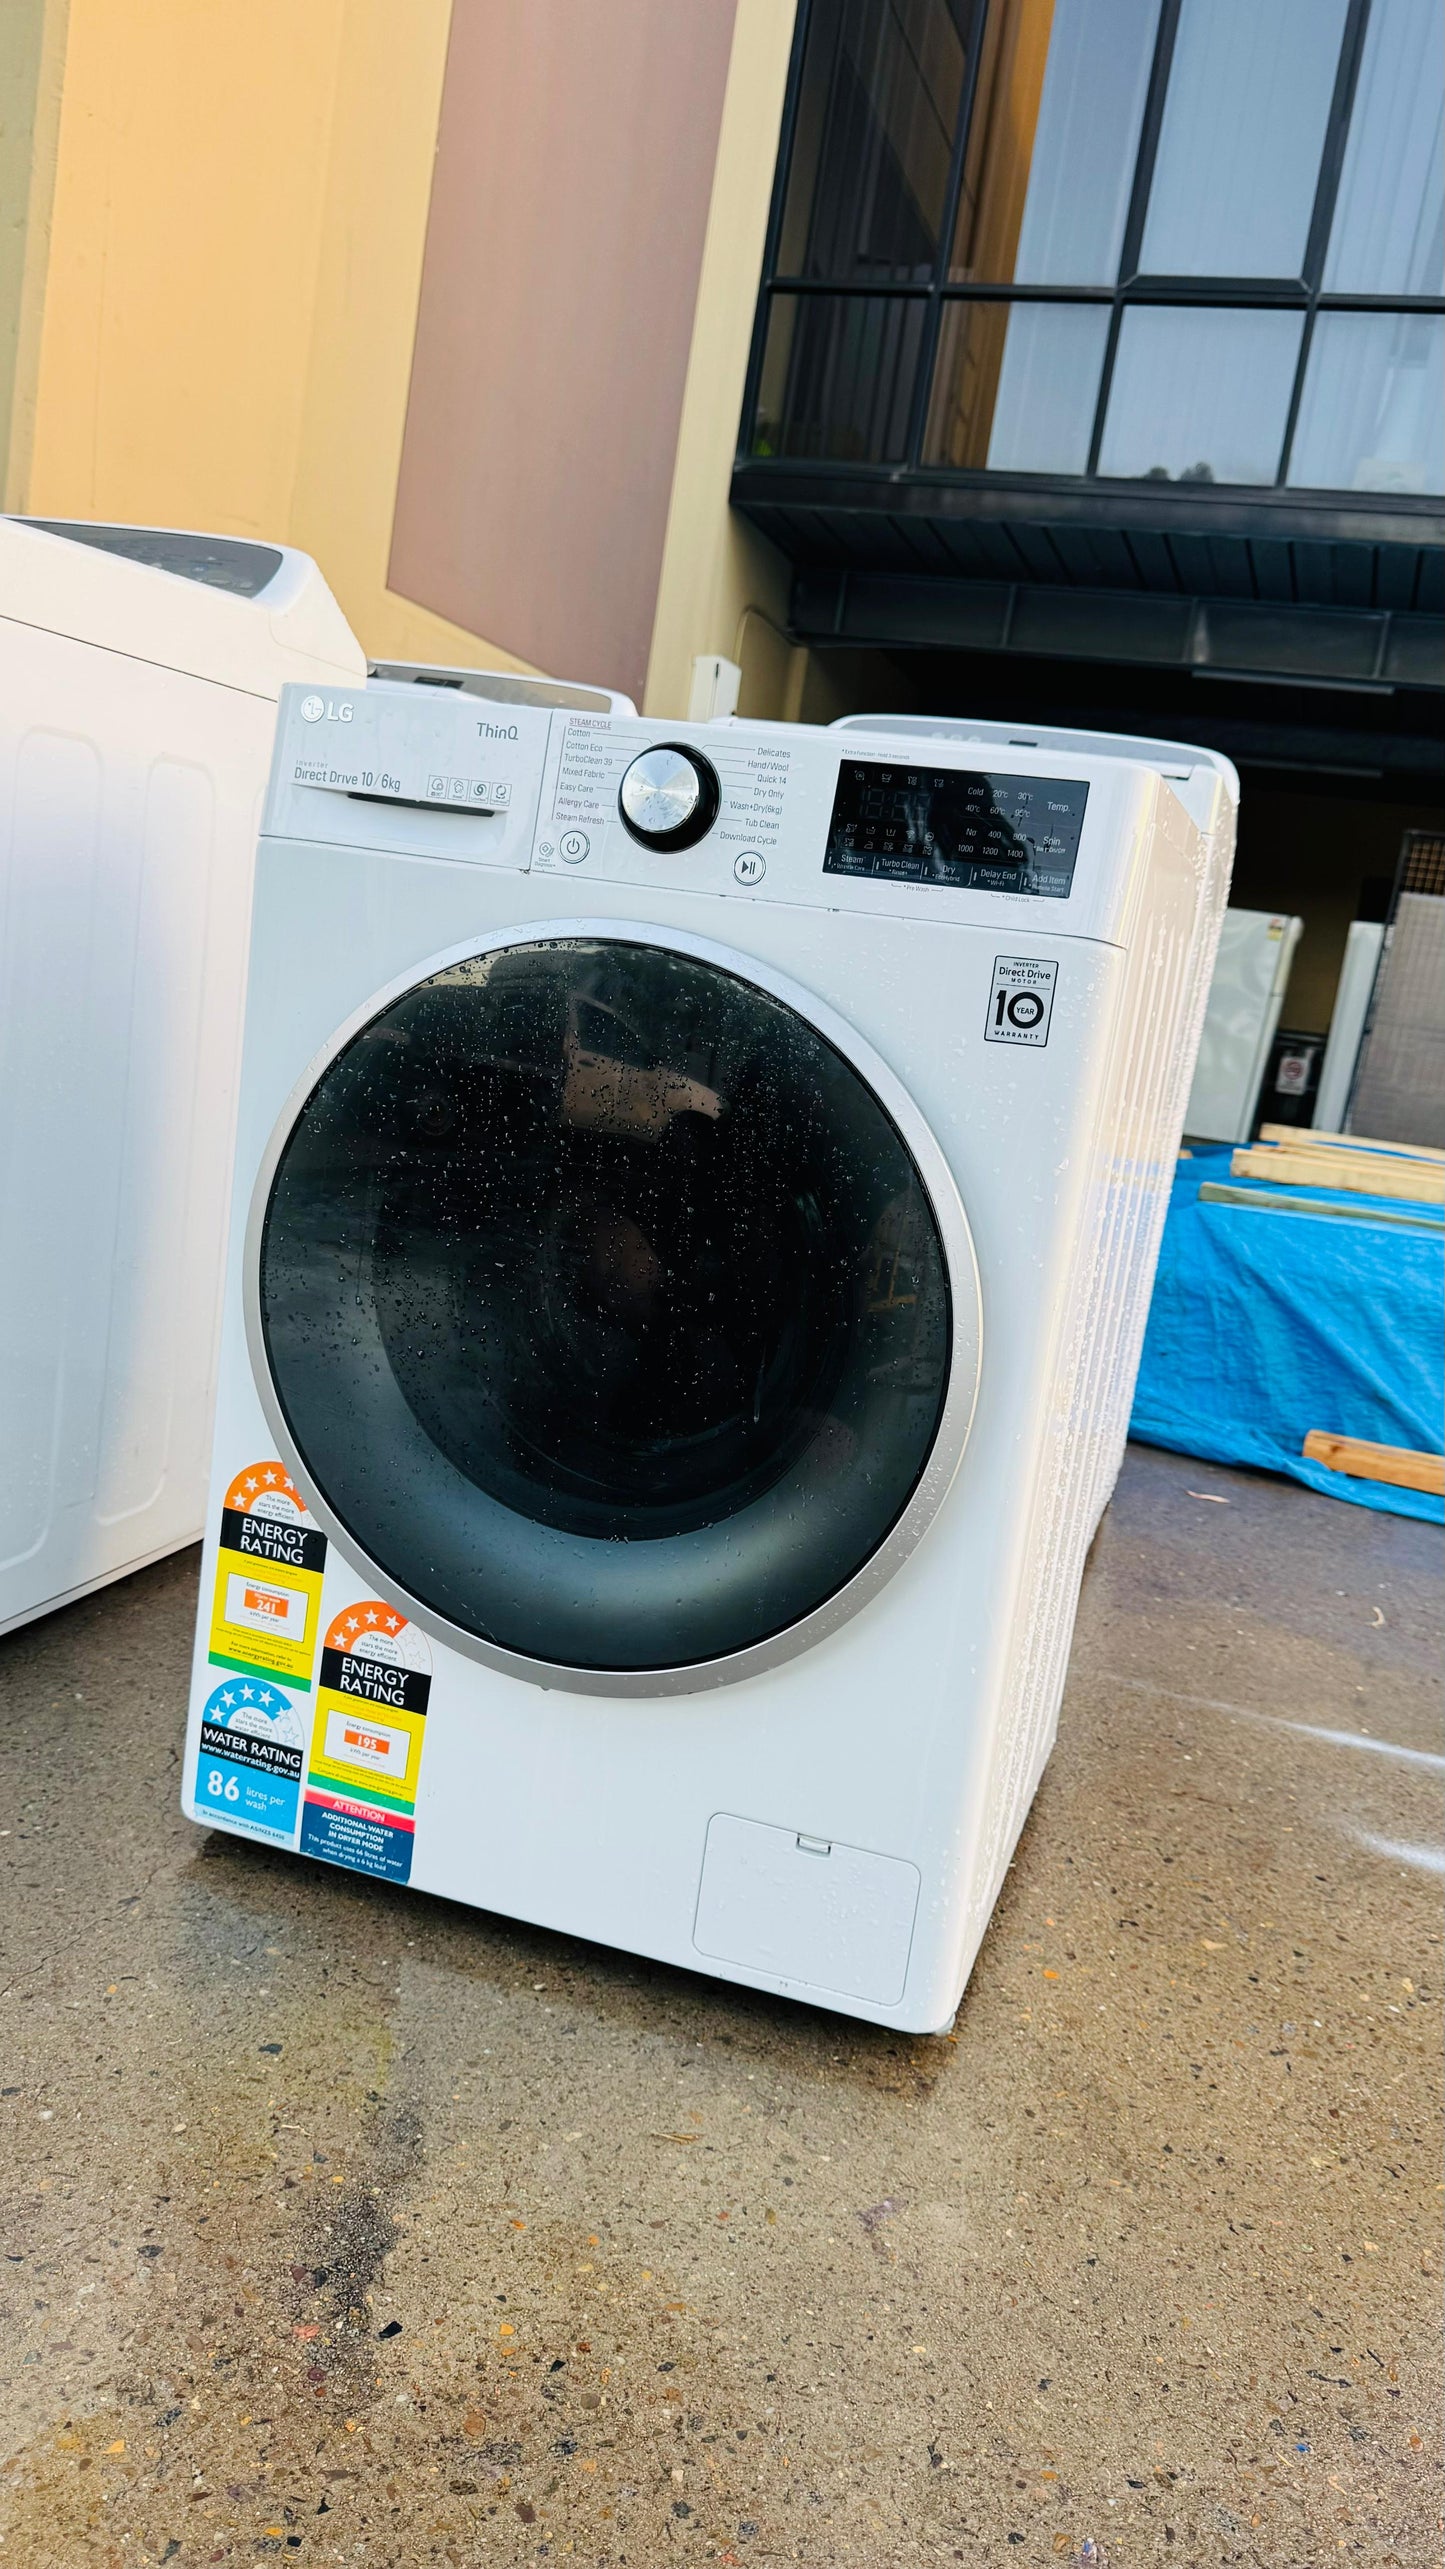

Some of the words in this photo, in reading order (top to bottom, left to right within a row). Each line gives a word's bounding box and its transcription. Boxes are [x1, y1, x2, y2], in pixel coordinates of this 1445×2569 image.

[327, 702, 354, 722] LG
[569, 718, 592, 726] STEAM
[592, 720, 612, 728] CYCLE
[477, 722, 519, 741] ThinQ
[567, 728, 590, 737] Cotton
[566, 741, 588, 750] Cotton
[590, 744, 603, 752] Eco
[757, 747, 791, 758] Delicates
[296, 760, 329, 769] Inverter
[565, 753, 603, 764] TurboClean
[747, 760, 789, 772] Hand/Wool
[294, 767, 327, 782] Direct
[329, 770, 359, 785] Drive
[562, 767, 583, 776] Mixed
[584, 769, 605, 778] Fabric
[757, 774, 778, 784] Quick
[560, 782, 577, 792] Easy
[578, 784, 594, 793] Care
[967, 787, 984, 796] Cold
[754, 788, 767, 798] Dry
[768, 789, 785, 800] Only
[558, 797, 582, 808] Allergy
[584, 800, 599, 809] Care
[730, 801, 783, 815] Wash+Dry(6kg)
[1047, 802, 1071, 812] Temp.
[555, 812, 577, 822] Steam
[579, 815, 604, 825] Refresh
[745, 818, 758, 827] Tub
[760, 820, 780, 829] Clean
[720, 831, 755, 842] Download
[757, 836, 777, 845] Cycle
[966, 828, 977, 836] No
[988, 831, 1002, 839] 400
[1013, 833, 1027, 842] 800
[1043, 836, 1061, 846] Spin
[958, 844, 974, 853] 1000
[982, 847, 999, 856] 1200
[1007, 849, 1024, 858] 1400
[881, 859, 901, 868] Turbo
[901, 860, 920, 869] Clean
[942, 865, 956, 874] Dry
[980, 869, 1002, 879] Delay
[1002, 871, 1017, 880] End
[1032, 874, 1048, 883] Add
[1049, 876, 1066, 885] Item
[999, 966, 1025, 977] Direct
[1027, 970, 1051, 980] Drive
[995, 989, 1044, 1029] 10
[1016, 1007, 1035, 1015] YEAR
[994, 1030, 1039, 1040] WARRANTY
[258, 1502, 271, 1510] stars
[277, 1498, 291, 1506] more
[257, 1508, 274, 1517] energy
[242, 1518, 308, 1547] ENERGY
[240, 1536, 304, 1564] RATING
[256, 1600, 276, 1614] 241
[369, 1634, 378, 1642] The
[380, 1638, 394, 1646] more
[359, 1648, 376, 1657] energy
[361, 1642, 373, 1650] stars
[384, 1647, 398, 1655] more
[341, 1657, 410, 1688] ENERGY
[339, 1675, 405, 1706] RATING
[236, 1718, 247, 1727] stars
[249, 1721, 258, 1729] the
[258, 1724, 273, 1733] more
[253, 1715, 268, 1724] more
[235, 1725, 249, 1733] water
[251, 1728, 271, 1739] efficient
[203, 1727, 248, 1752] WATER
[251, 1743, 301, 1768] RATING
[356, 1737, 377, 1750] 195
[201, 1742, 300, 1779] www.waterrating.gov.au
[207, 1770, 240, 1802] 86
[246, 1787, 268, 1801] litres
[269, 1795, 285, 1807] per
[245, 1799, 267, 1811] wash
[333, 1800, 385, 1822] ATTENTION
[322, 1812, 367, 1830] ADDITIONAL
[368, 1826, 394, 1839] WATER
[329, 1823, 384, 1844] CONSUMPTION
[338, 1833, 361, 1845] DRYER
[362, 1840, 384, 1852] MODE
[308, 1834, 319, 1842] This
[320, 1838, 342, 1849] product
[343, 1845, 355, 1853] uses
[364, 1850, 379, 1861] litres
[386, 1859, 403, 1867] water
[322, 1848, 338, 1856] when
[338, 1851, 356, 1863] drying
[366, 1859, 373, 1868] kg
[374, 1861, 387, 1871] load
